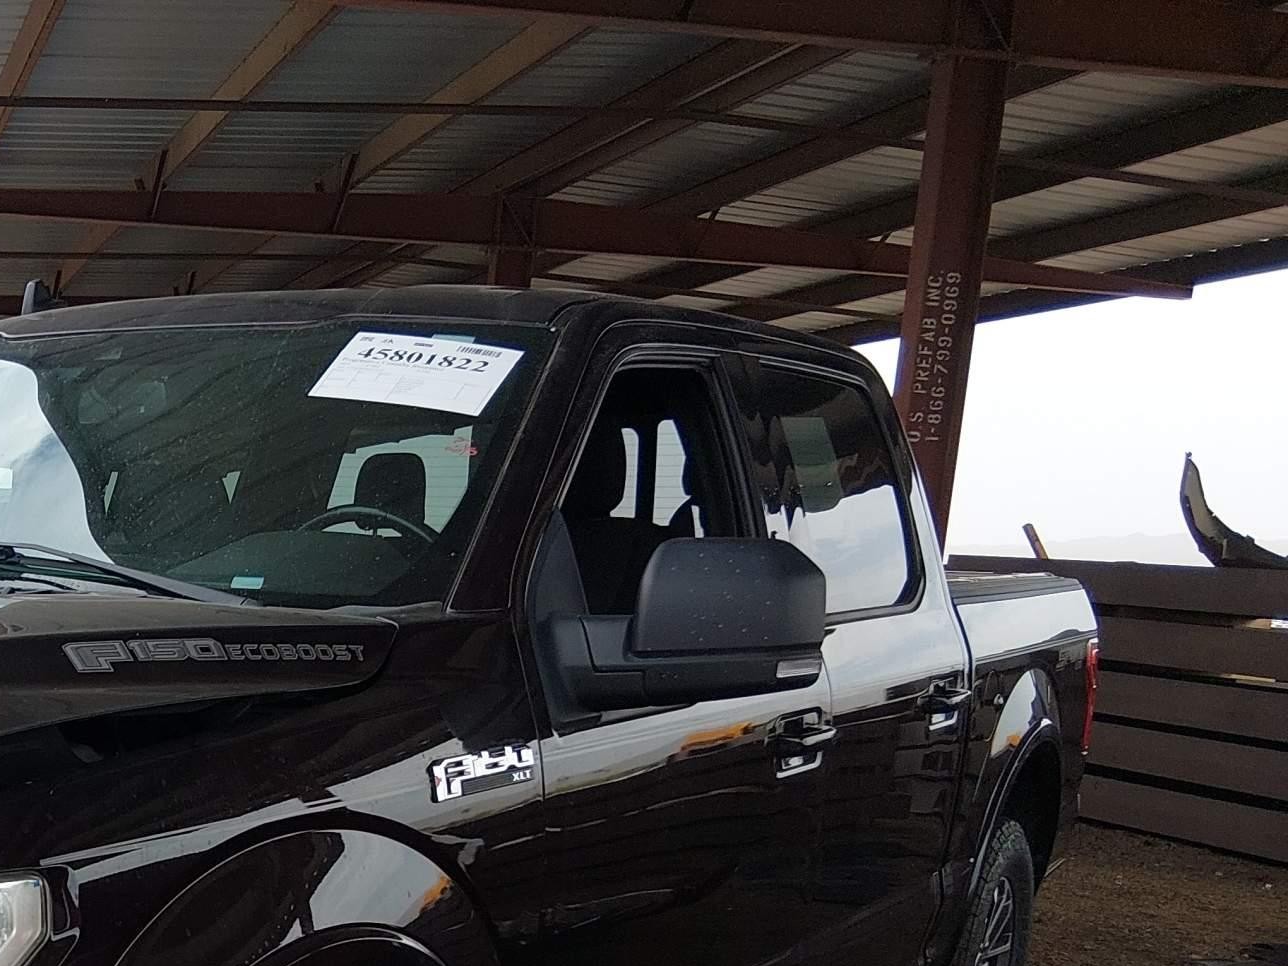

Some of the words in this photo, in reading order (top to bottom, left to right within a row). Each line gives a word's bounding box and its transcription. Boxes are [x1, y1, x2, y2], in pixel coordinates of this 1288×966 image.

[357, 346, 491, 373] 45801822
[912, 317, 938, 394] PREFAB
[925, 271, 962, 442] 1-866-799-0969
[225, 642, 366, 663] ECOBOOST
[511, 769, 532, 782] XLT
